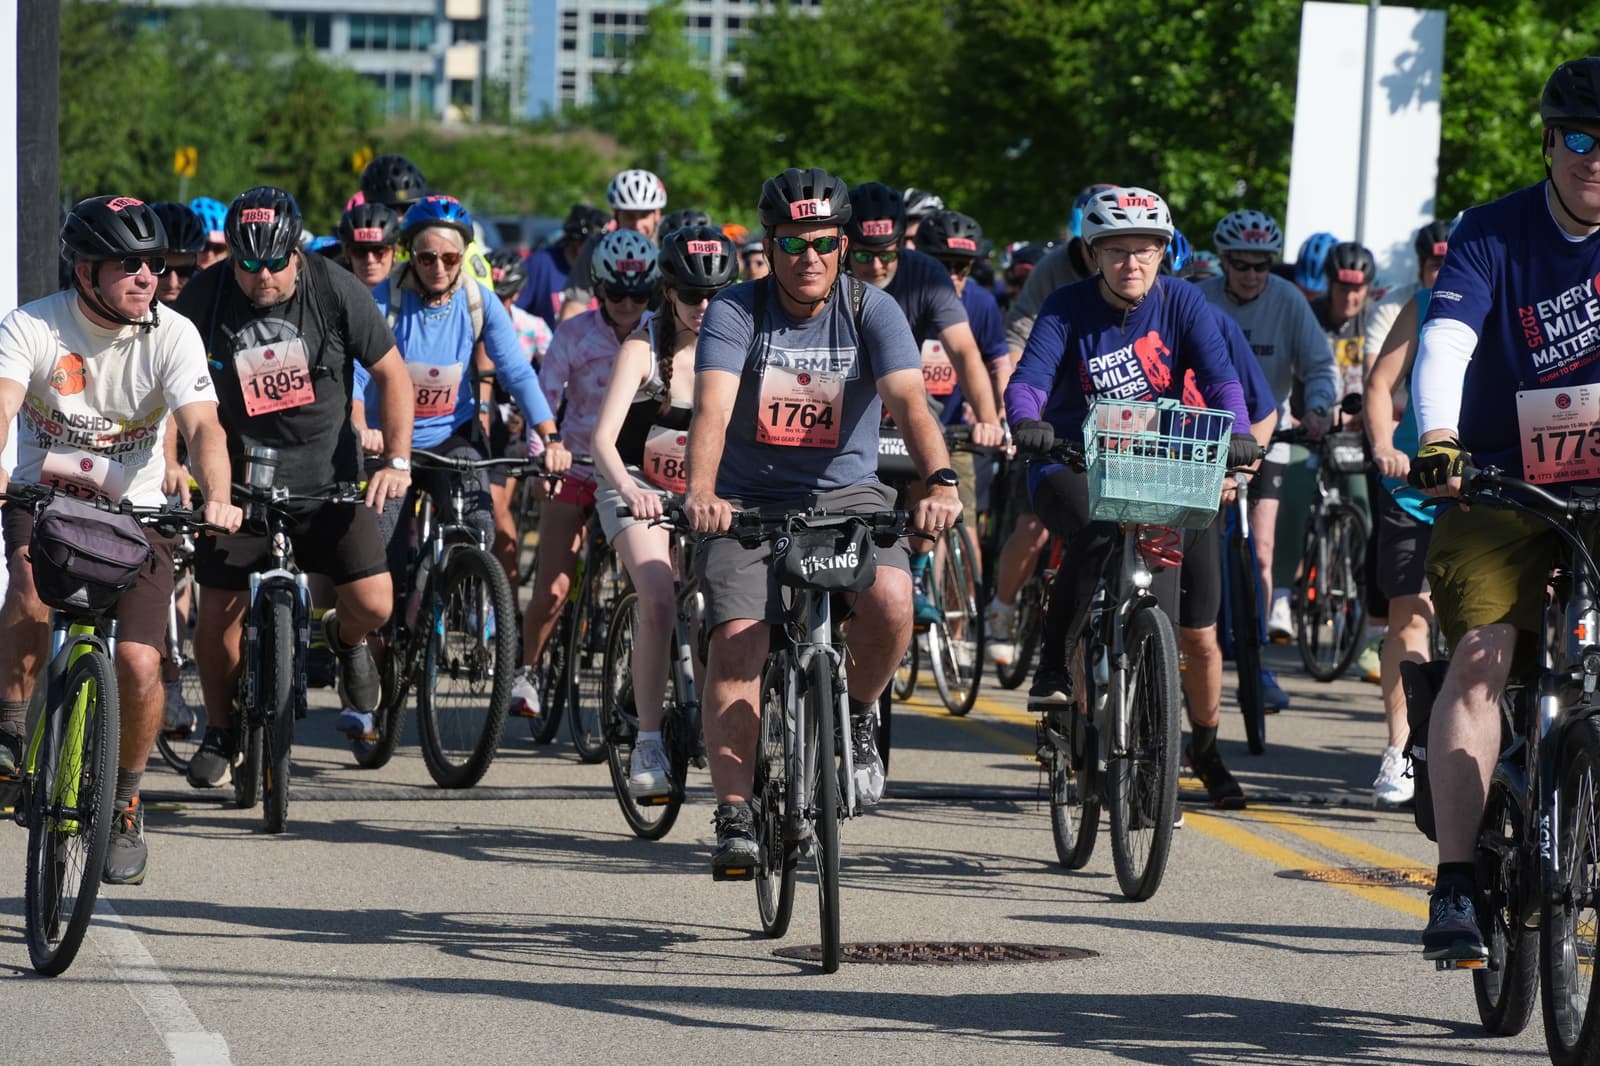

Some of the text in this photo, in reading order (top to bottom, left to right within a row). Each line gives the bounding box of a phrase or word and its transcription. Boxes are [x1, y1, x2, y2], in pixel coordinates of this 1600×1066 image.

[246, 209, 270, 221] 1895
[1536, 278, 1593, 320] EVERY
[1518, 305, 1544, 348] 2025
[1543, 298, 1600, 342] MILE
[1088, 343, 1134, 374] EVERY
[1531, 325, 1600, 368] MATTER
[794, 358, 852, 372] RMEF
[1092, 359, 1142, 390] MILE
[248, 369, 304, 400] 1895
[416, 388, 451, 406] 871
[51, 410, 113, 431] FINISHED
[768, 401, 834, 430] 1764
[67, 430, 93, 446] THE
[1531, 427, 1600, 463] 1773
